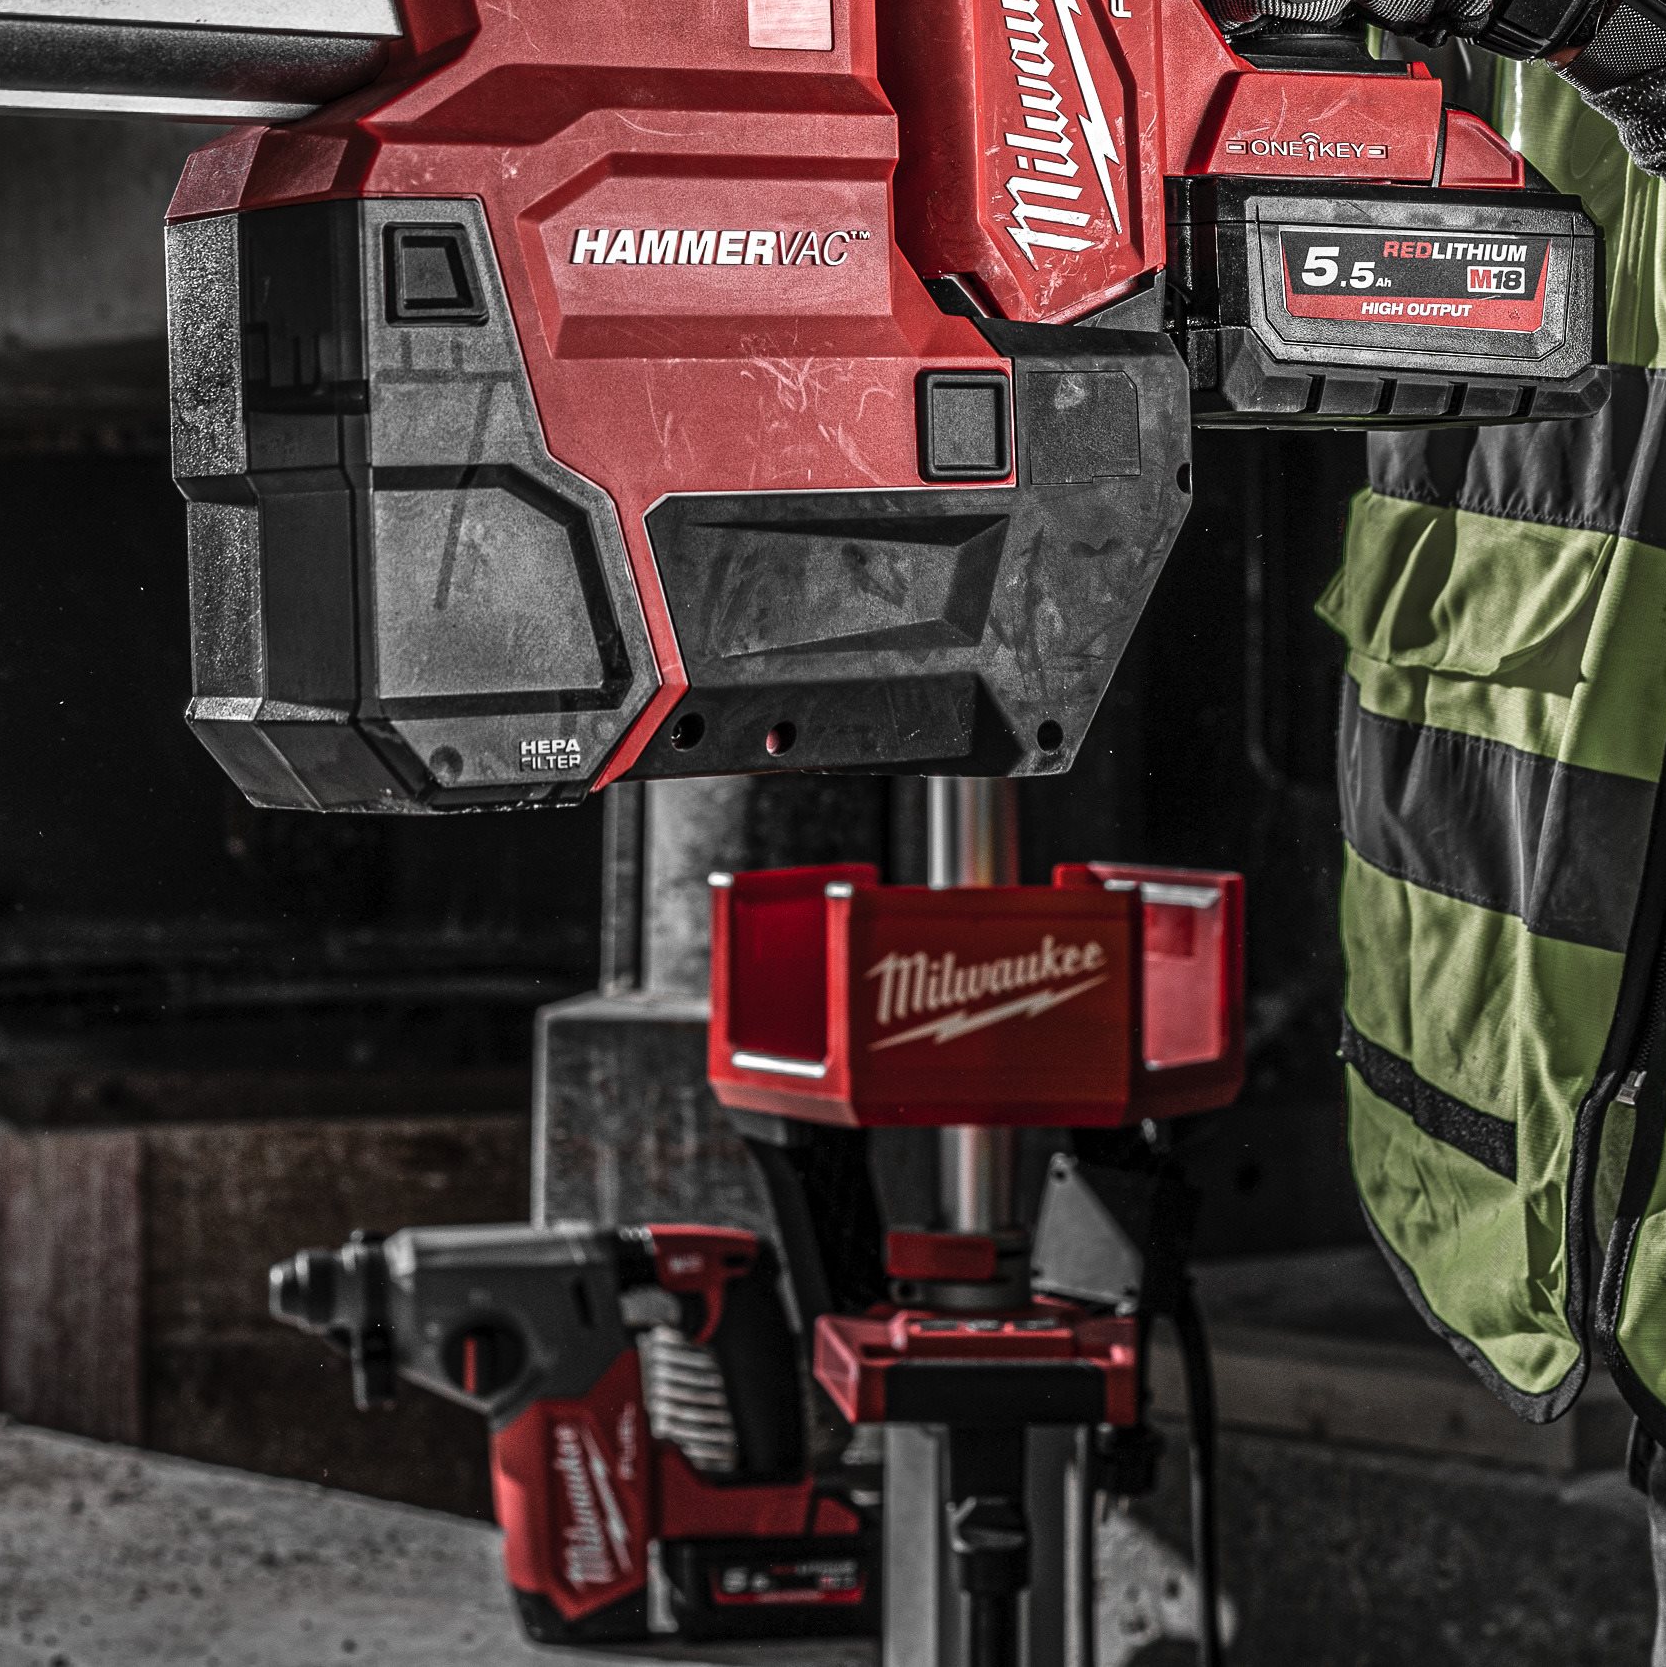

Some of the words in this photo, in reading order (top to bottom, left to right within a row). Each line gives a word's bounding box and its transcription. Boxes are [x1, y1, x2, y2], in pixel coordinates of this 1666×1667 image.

[1383, 240, 1528, 263] REDLITHIUM
[1469, 269, 1523, 291] M18
[1361, 301, 1403, 316] HIGH
[1406, 302, 1472, 318] OUTPUT
[520, 738, 581, 755] HEPA
[520, 754, 581, 772] FILTER
[864, 934, 1107, 1025] Milwaukee
